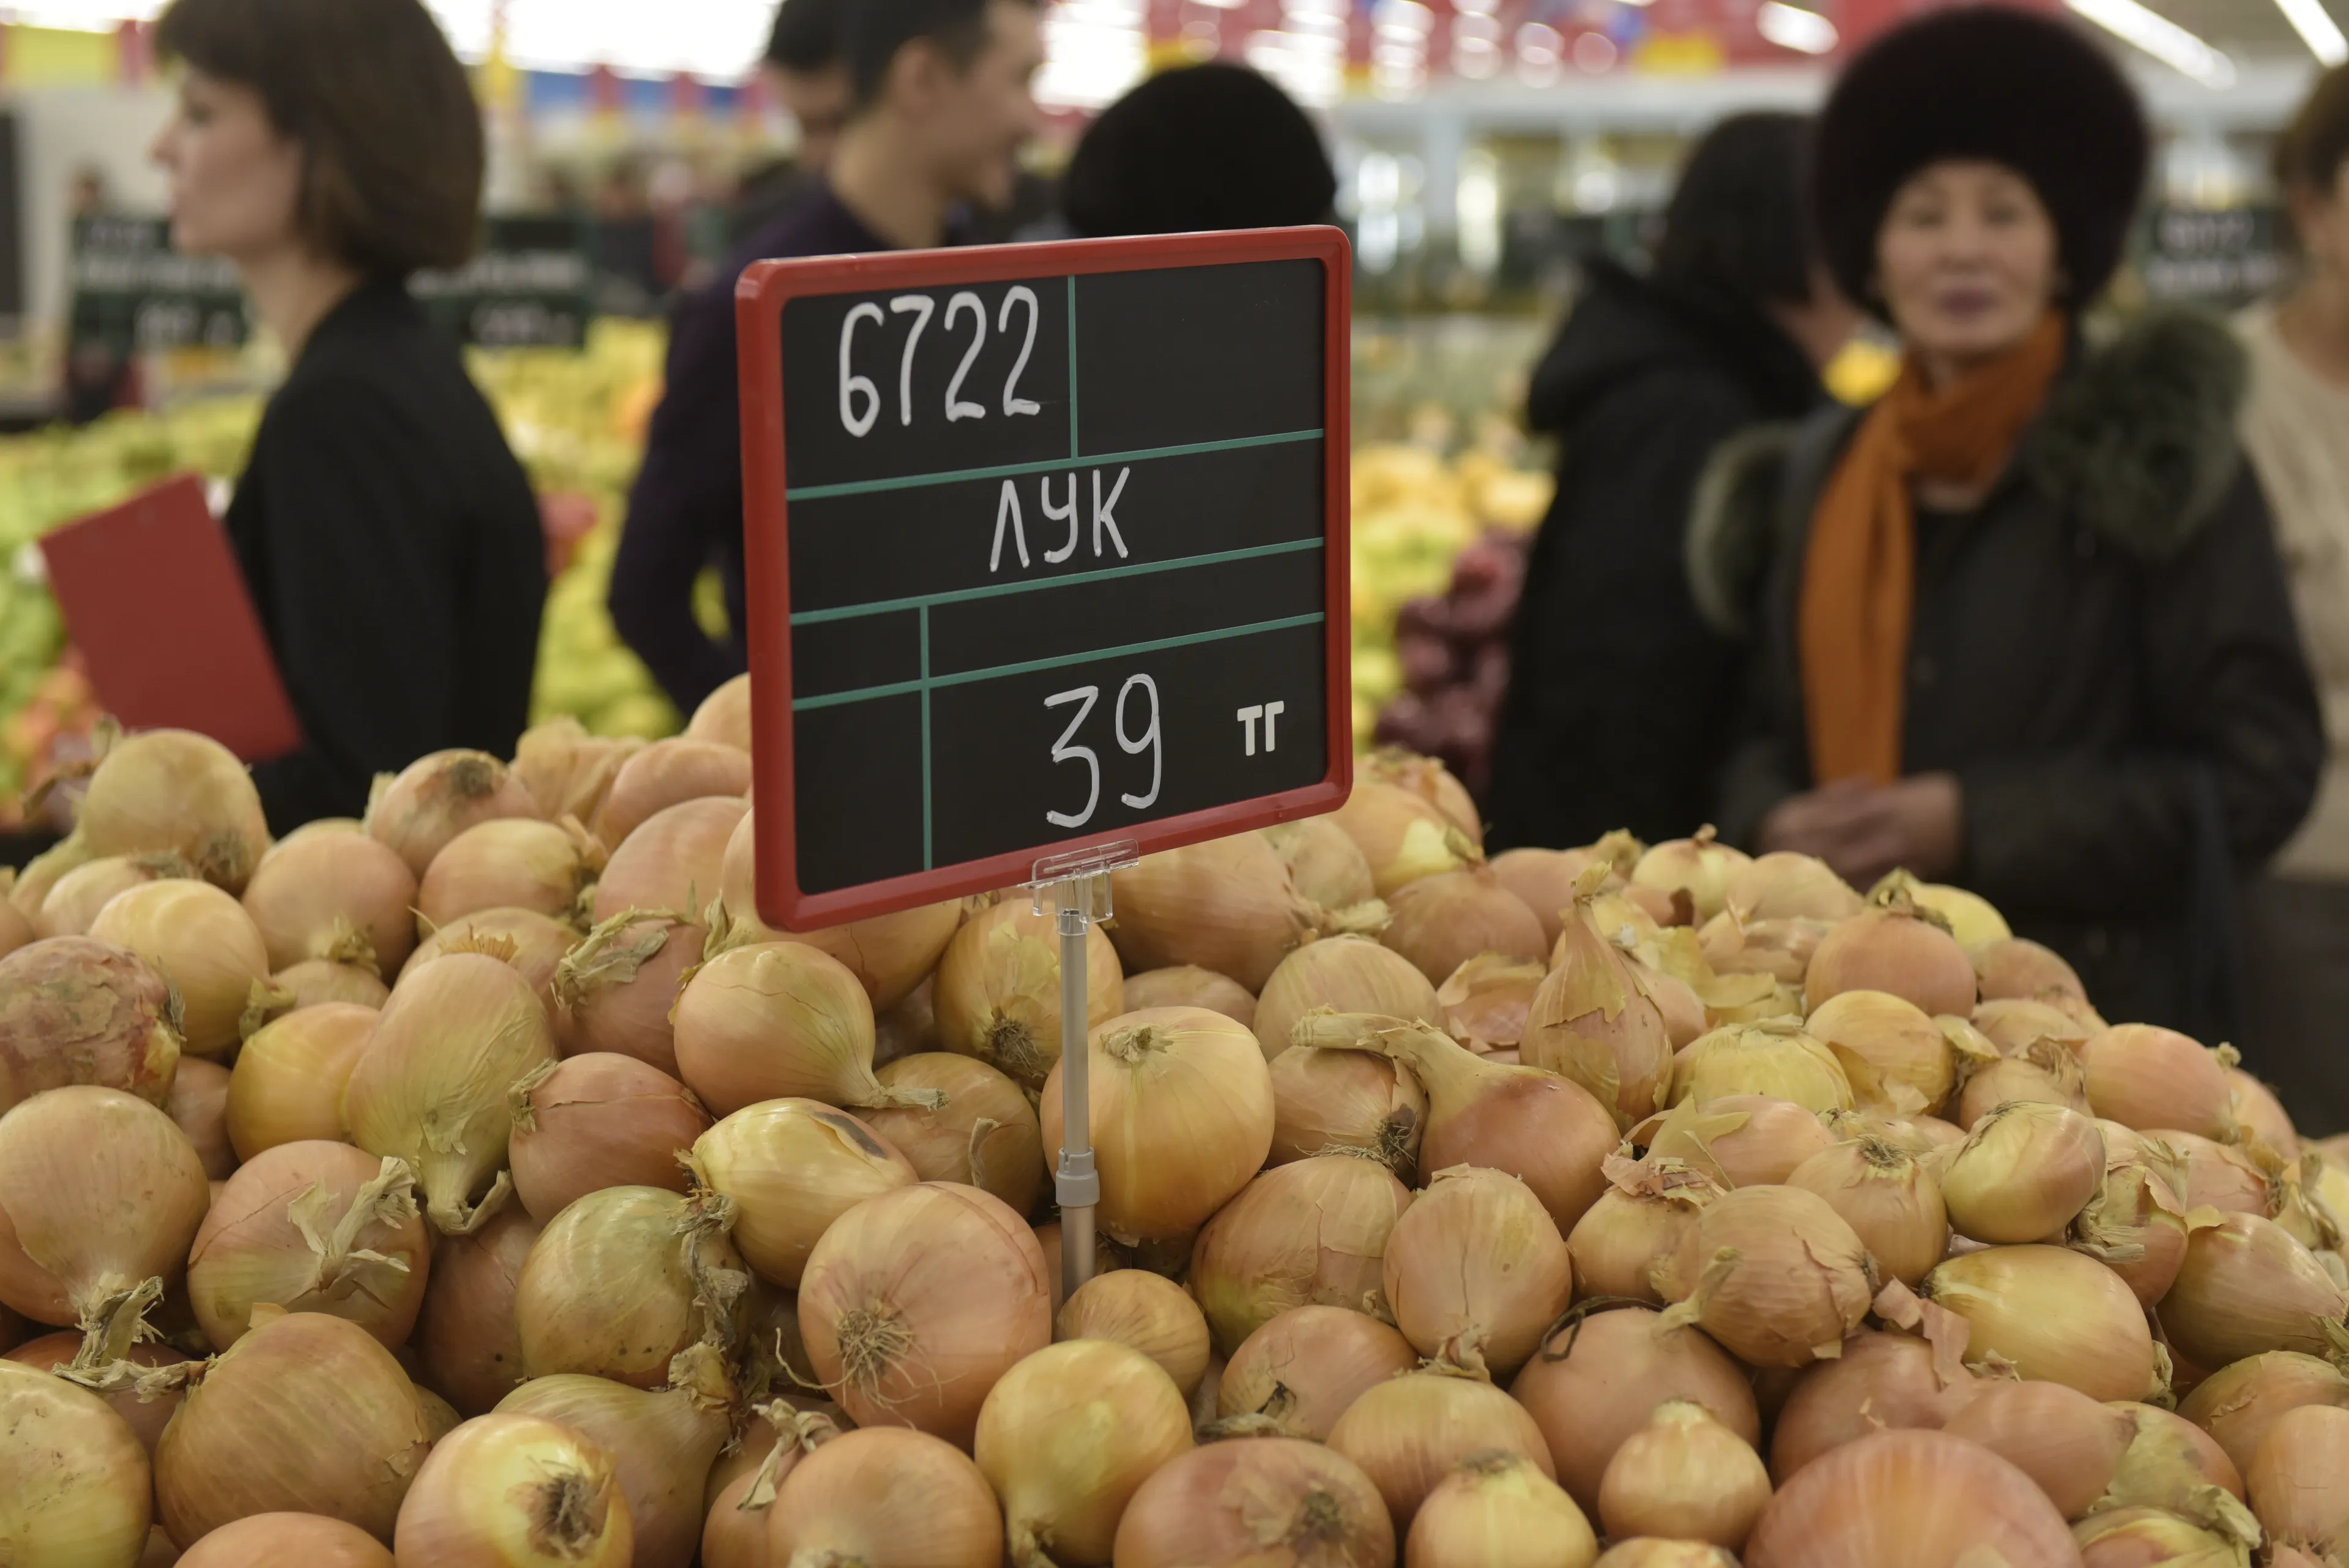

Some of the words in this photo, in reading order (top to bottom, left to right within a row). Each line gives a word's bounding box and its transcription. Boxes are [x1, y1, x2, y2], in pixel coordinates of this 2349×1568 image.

[840, 286, 1040, 437] 6722
[990, 467, 1130, 571] ЛУК
[1044, 674, 1161, 828] 39
